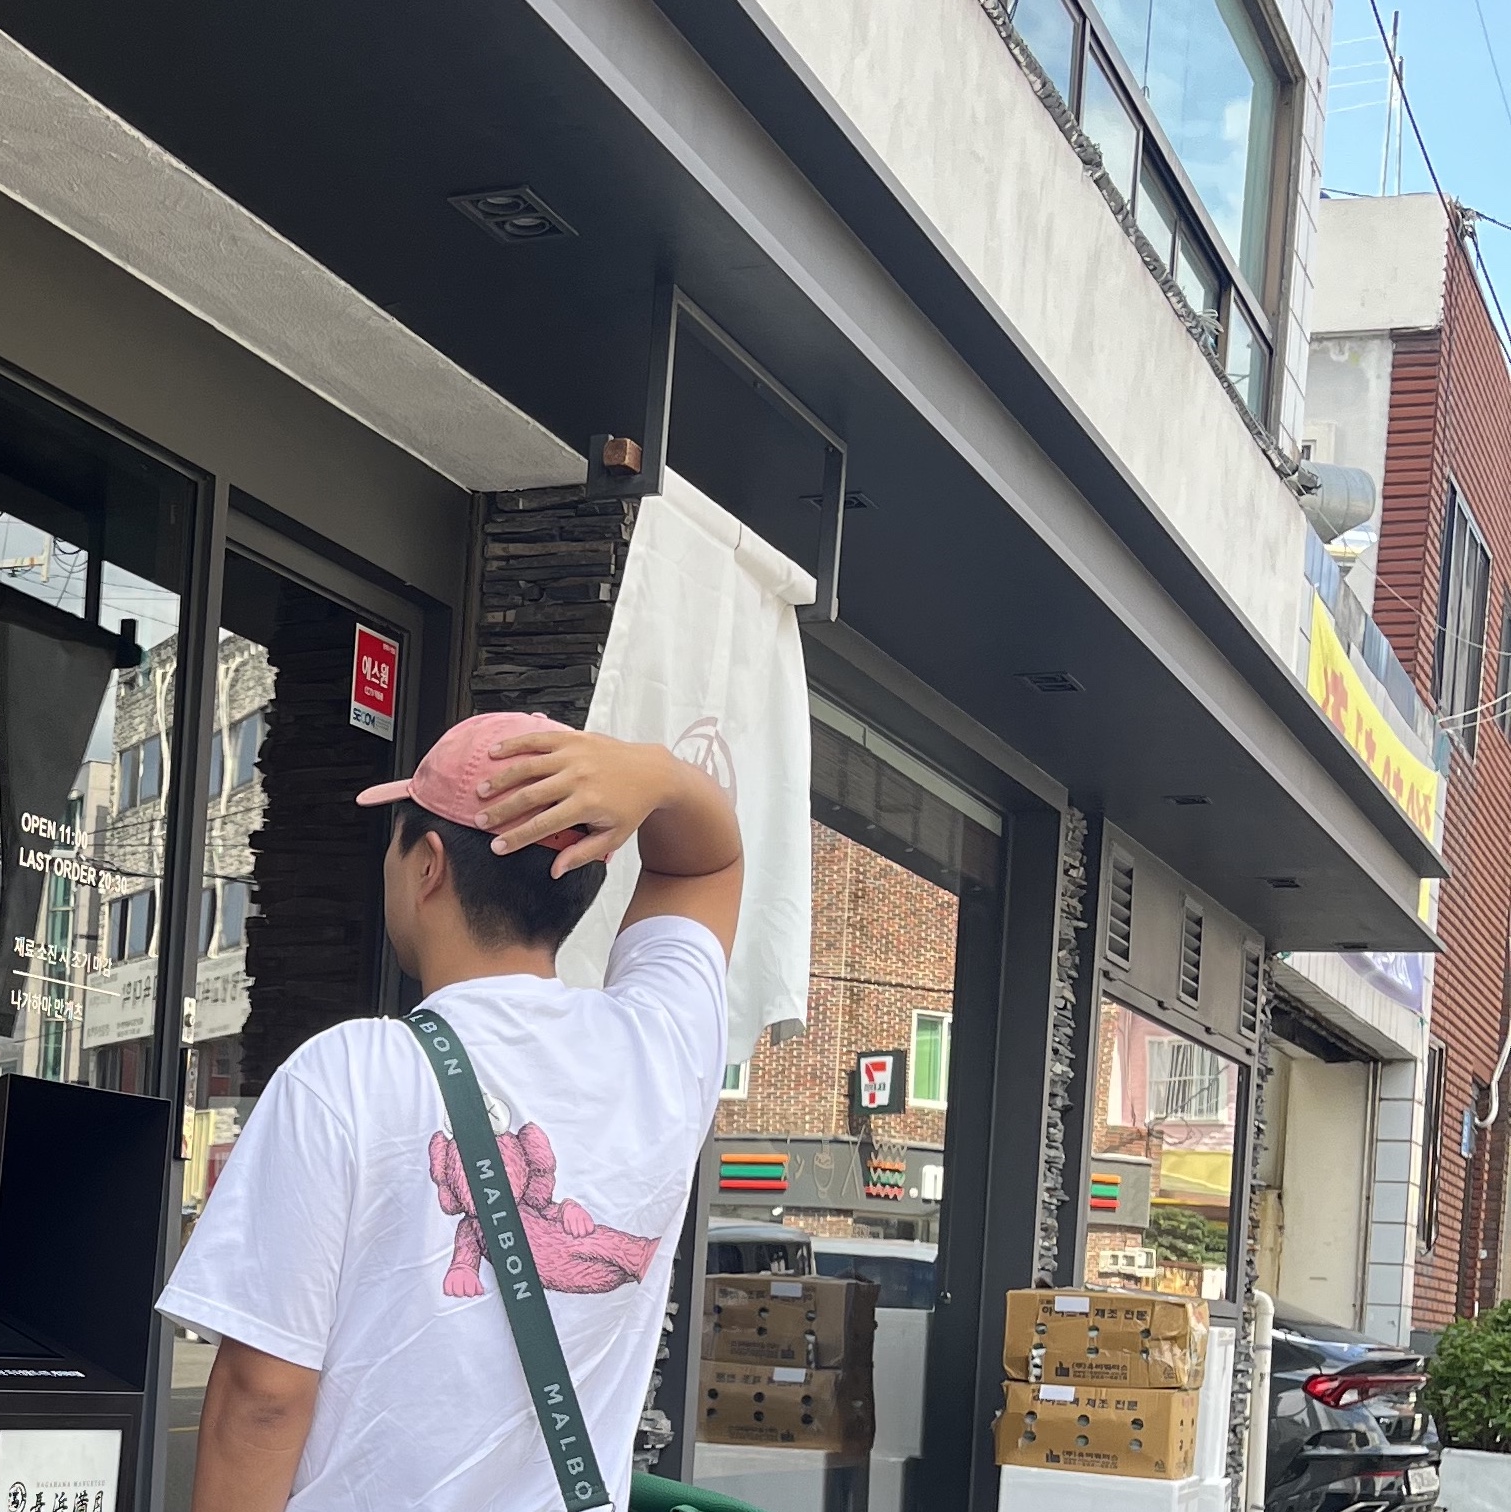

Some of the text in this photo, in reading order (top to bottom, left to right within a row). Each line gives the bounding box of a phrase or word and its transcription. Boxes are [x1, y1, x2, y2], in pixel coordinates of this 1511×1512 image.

[361, 655, 390, 689] 에스원
[21, 812, 88, 850] OPEN 11:00
[19, 847, 127, 895] LAST ORDER 20:30
[13, 936, 35, 958] 재료
[37, 943, 57, 965] 소진
[71, 950, 91, 972] 조기
[92, 955, 113, 978] 마감
[11, 989, 83, 1021] 나가하마 만게츠
[475, 1158, 532, 1300] MALBON
[543, 1383, 593, 1500] MALBO
